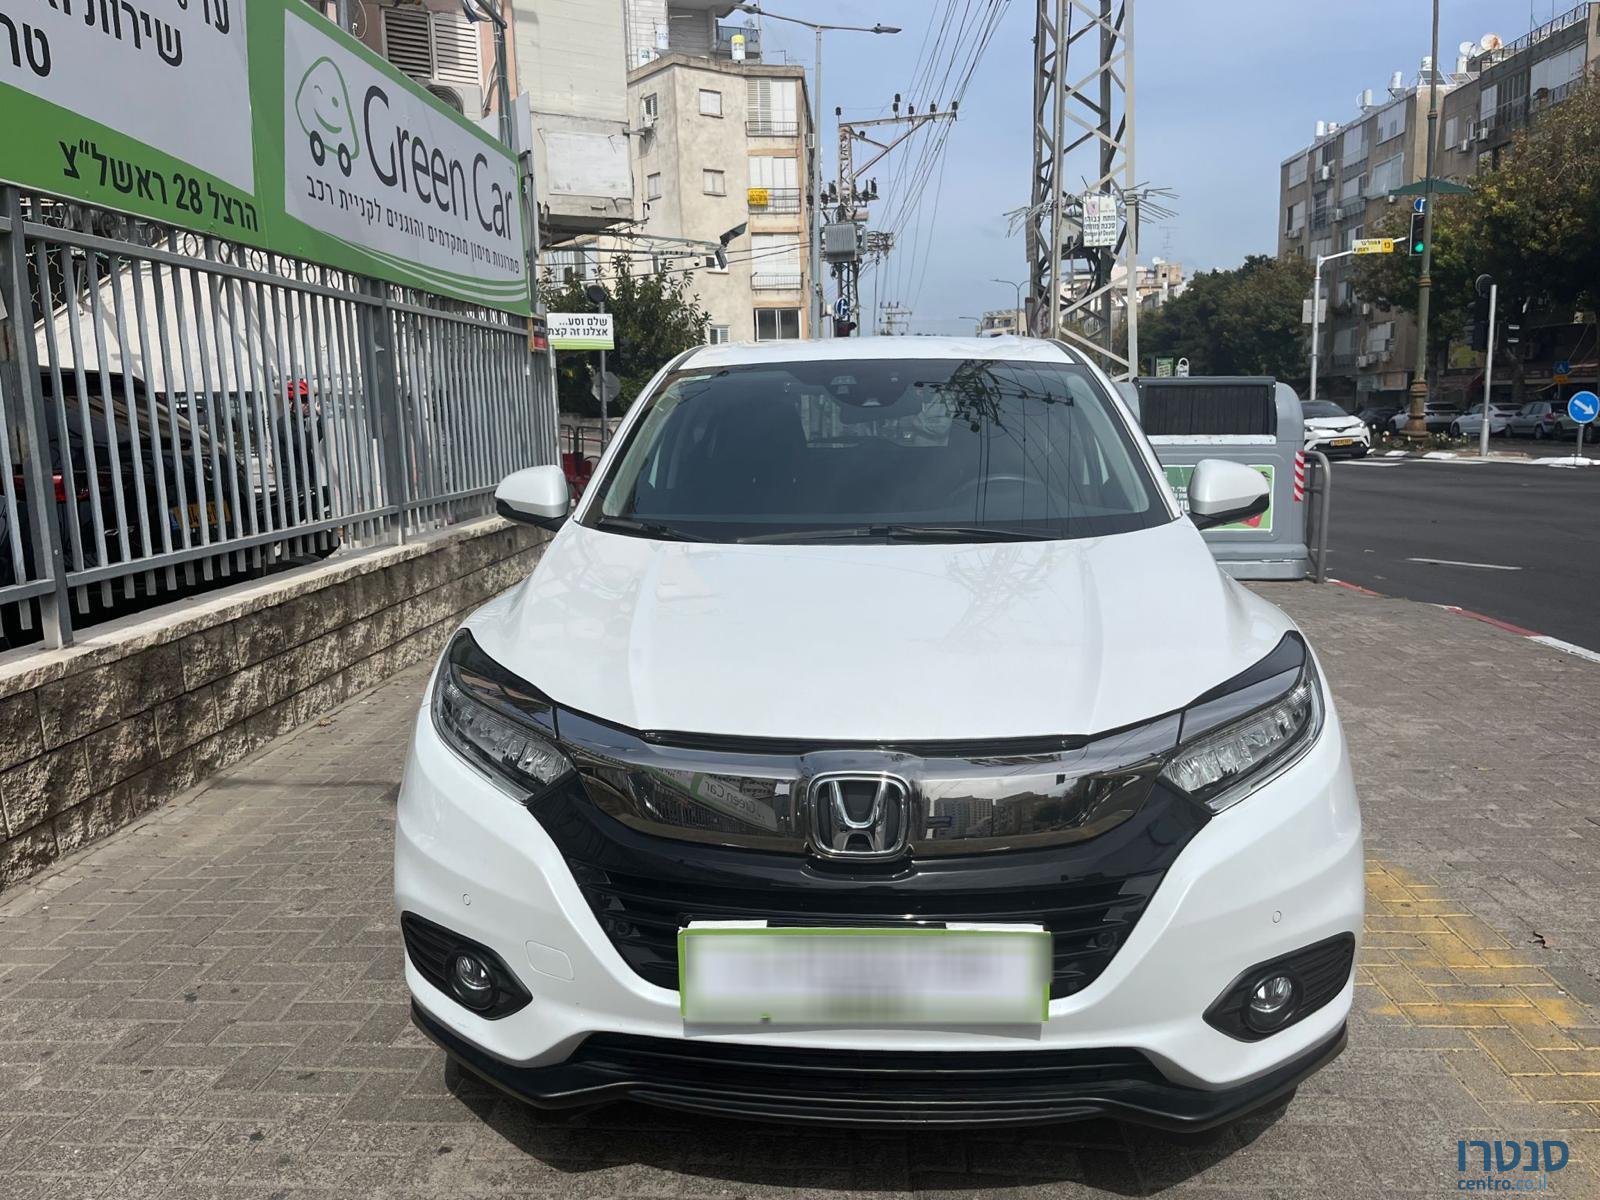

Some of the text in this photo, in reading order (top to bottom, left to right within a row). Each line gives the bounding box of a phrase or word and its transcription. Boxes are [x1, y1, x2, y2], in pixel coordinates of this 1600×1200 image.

[59, 138, 259, 232] הרצל 28 ראשל"צ
[363, 85, 513, 240] Green Car
[306, 175, 519, 274] פתרונות מימון מתקדמים והוגנים לקניית רכב
[547, 327, 608, 337] אצלנו זה קצת
[559, 316, 608, 326] שלם וסע...
